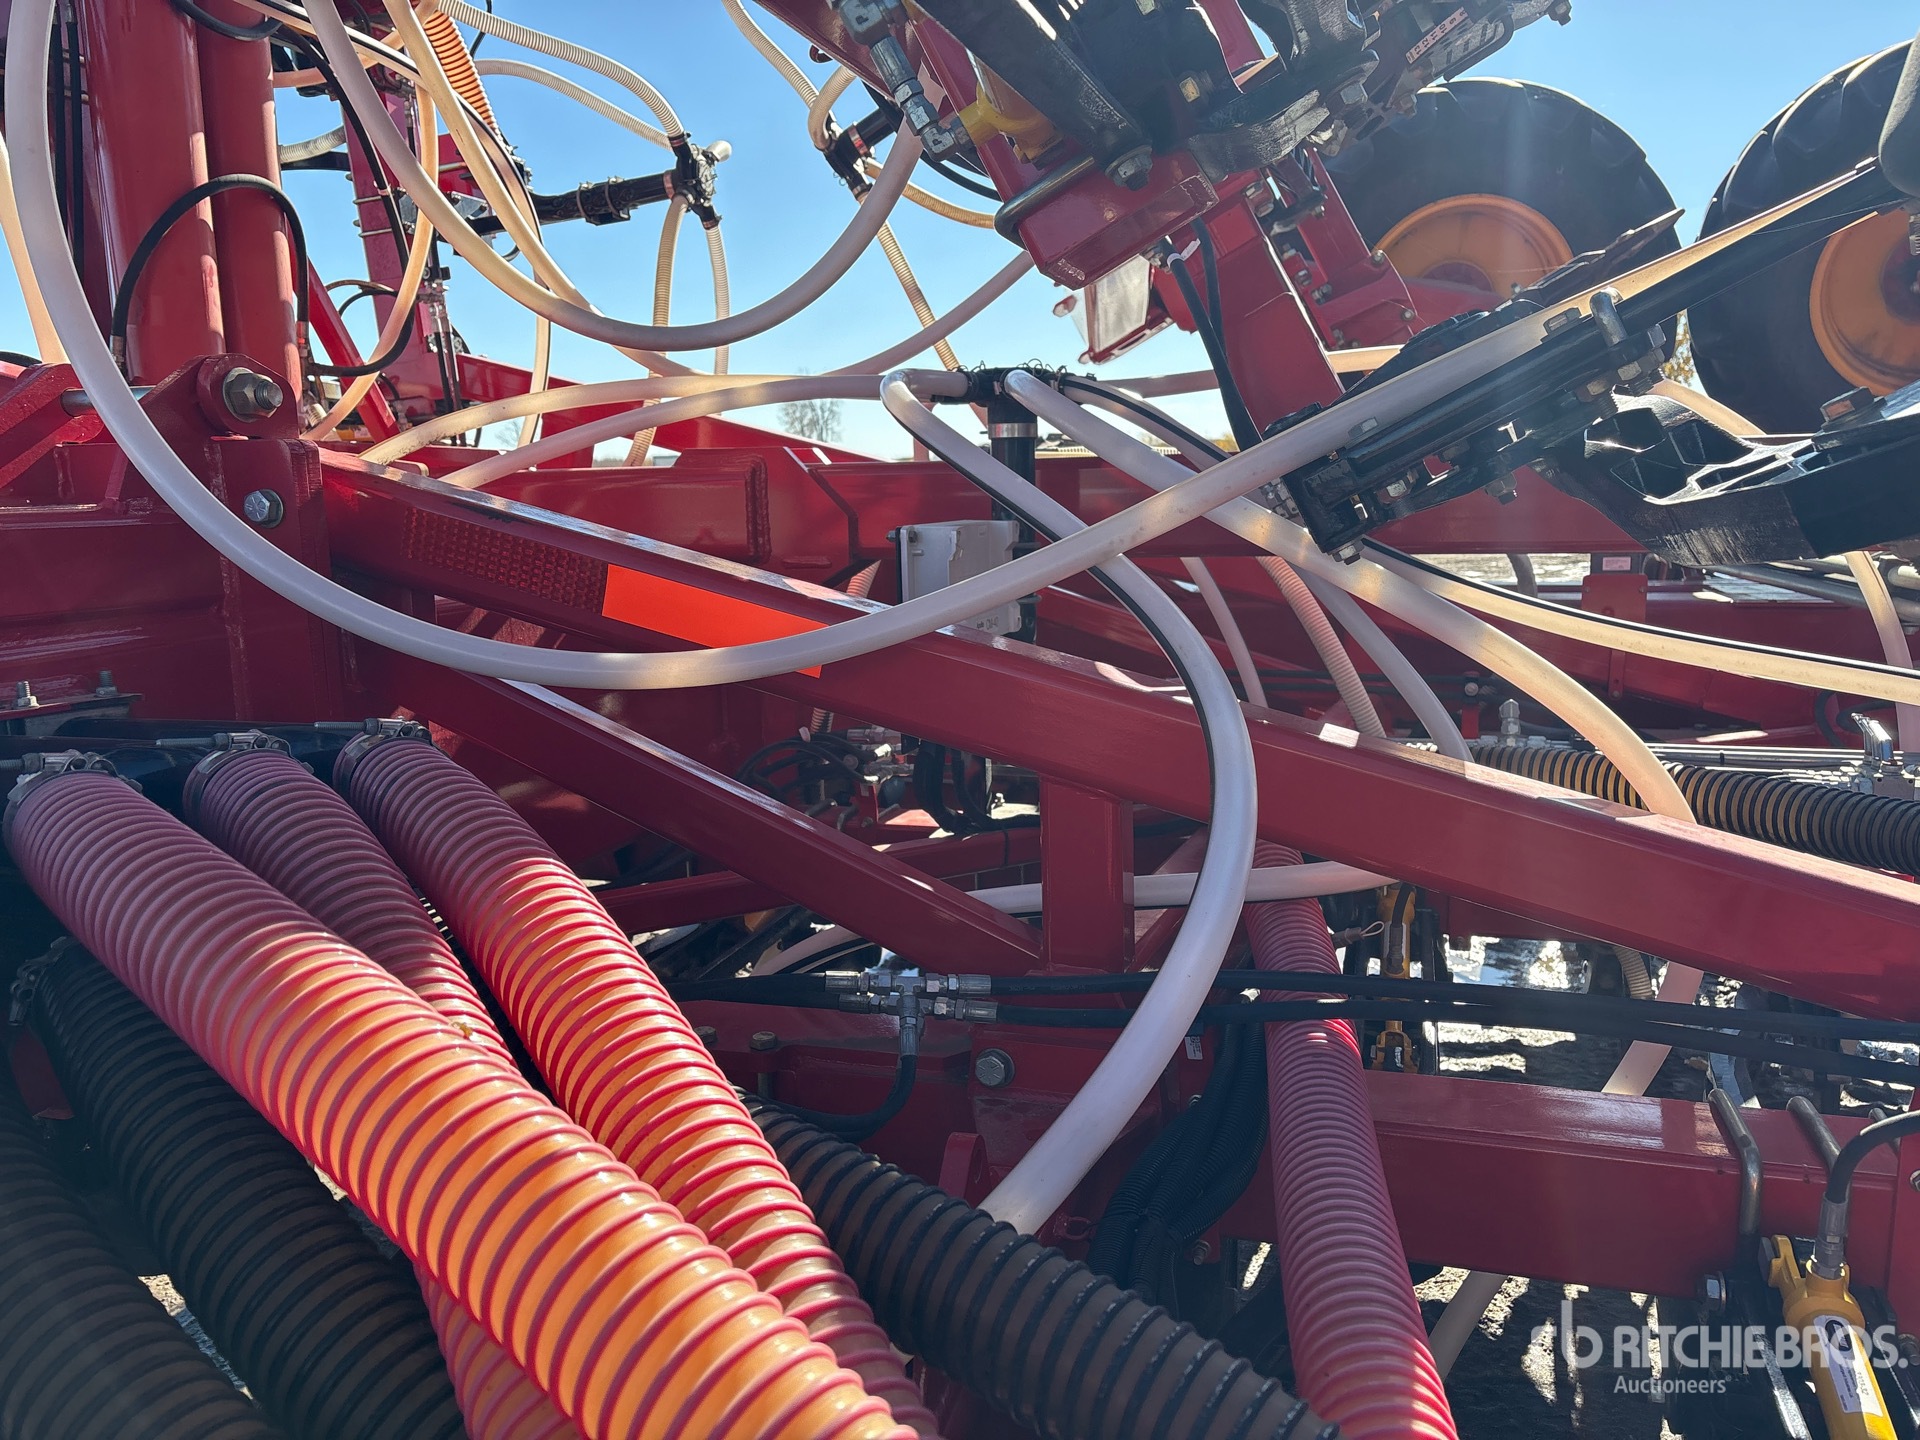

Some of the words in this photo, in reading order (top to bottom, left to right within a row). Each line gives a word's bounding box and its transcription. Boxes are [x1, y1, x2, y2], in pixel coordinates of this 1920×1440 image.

[1449, 17, 1457, 25] 9
[1439, 23, 1448, 34] 10
[1430, 31, 1438, 40] 11
[1422, 37, 1430, 48] 12
[1414, 45, 1422, 55] 13
